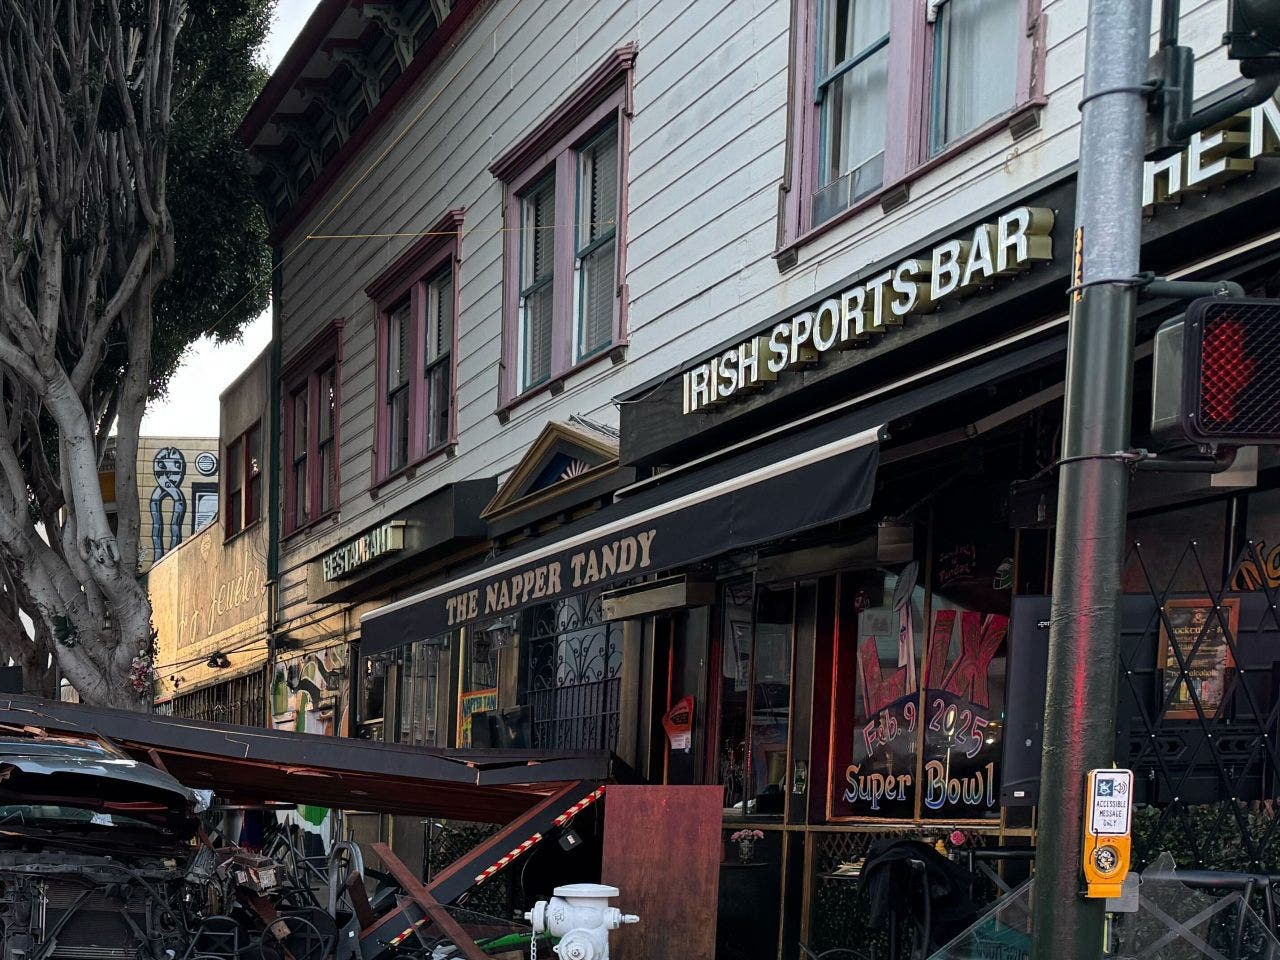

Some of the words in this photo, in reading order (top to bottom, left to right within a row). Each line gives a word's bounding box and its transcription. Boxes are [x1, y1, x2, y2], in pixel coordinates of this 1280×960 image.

[683, 336, 760, 414] IRISH
[768, 258, 920, 373] SPORTS
[931, 207, 1030, 300] BAR
[446, 589, 479, 626] THE
[484, 561, 562, 615] NAPPER
[571, 529, 657, 588] TANDY
[863, 709, 902, 758] Feb.
[903, 701, 917, 733] 9
[929, 698, 989, 759] 2025
[843, 764, 912, 811] Super
[925, 760, 996, 810] Bowl
[1096, 800, 1126, 808] ACCESSIBLE
[1100, 810, 1122, 818] MESSAGE
[1103, 819, 1117, 827] ONLY
